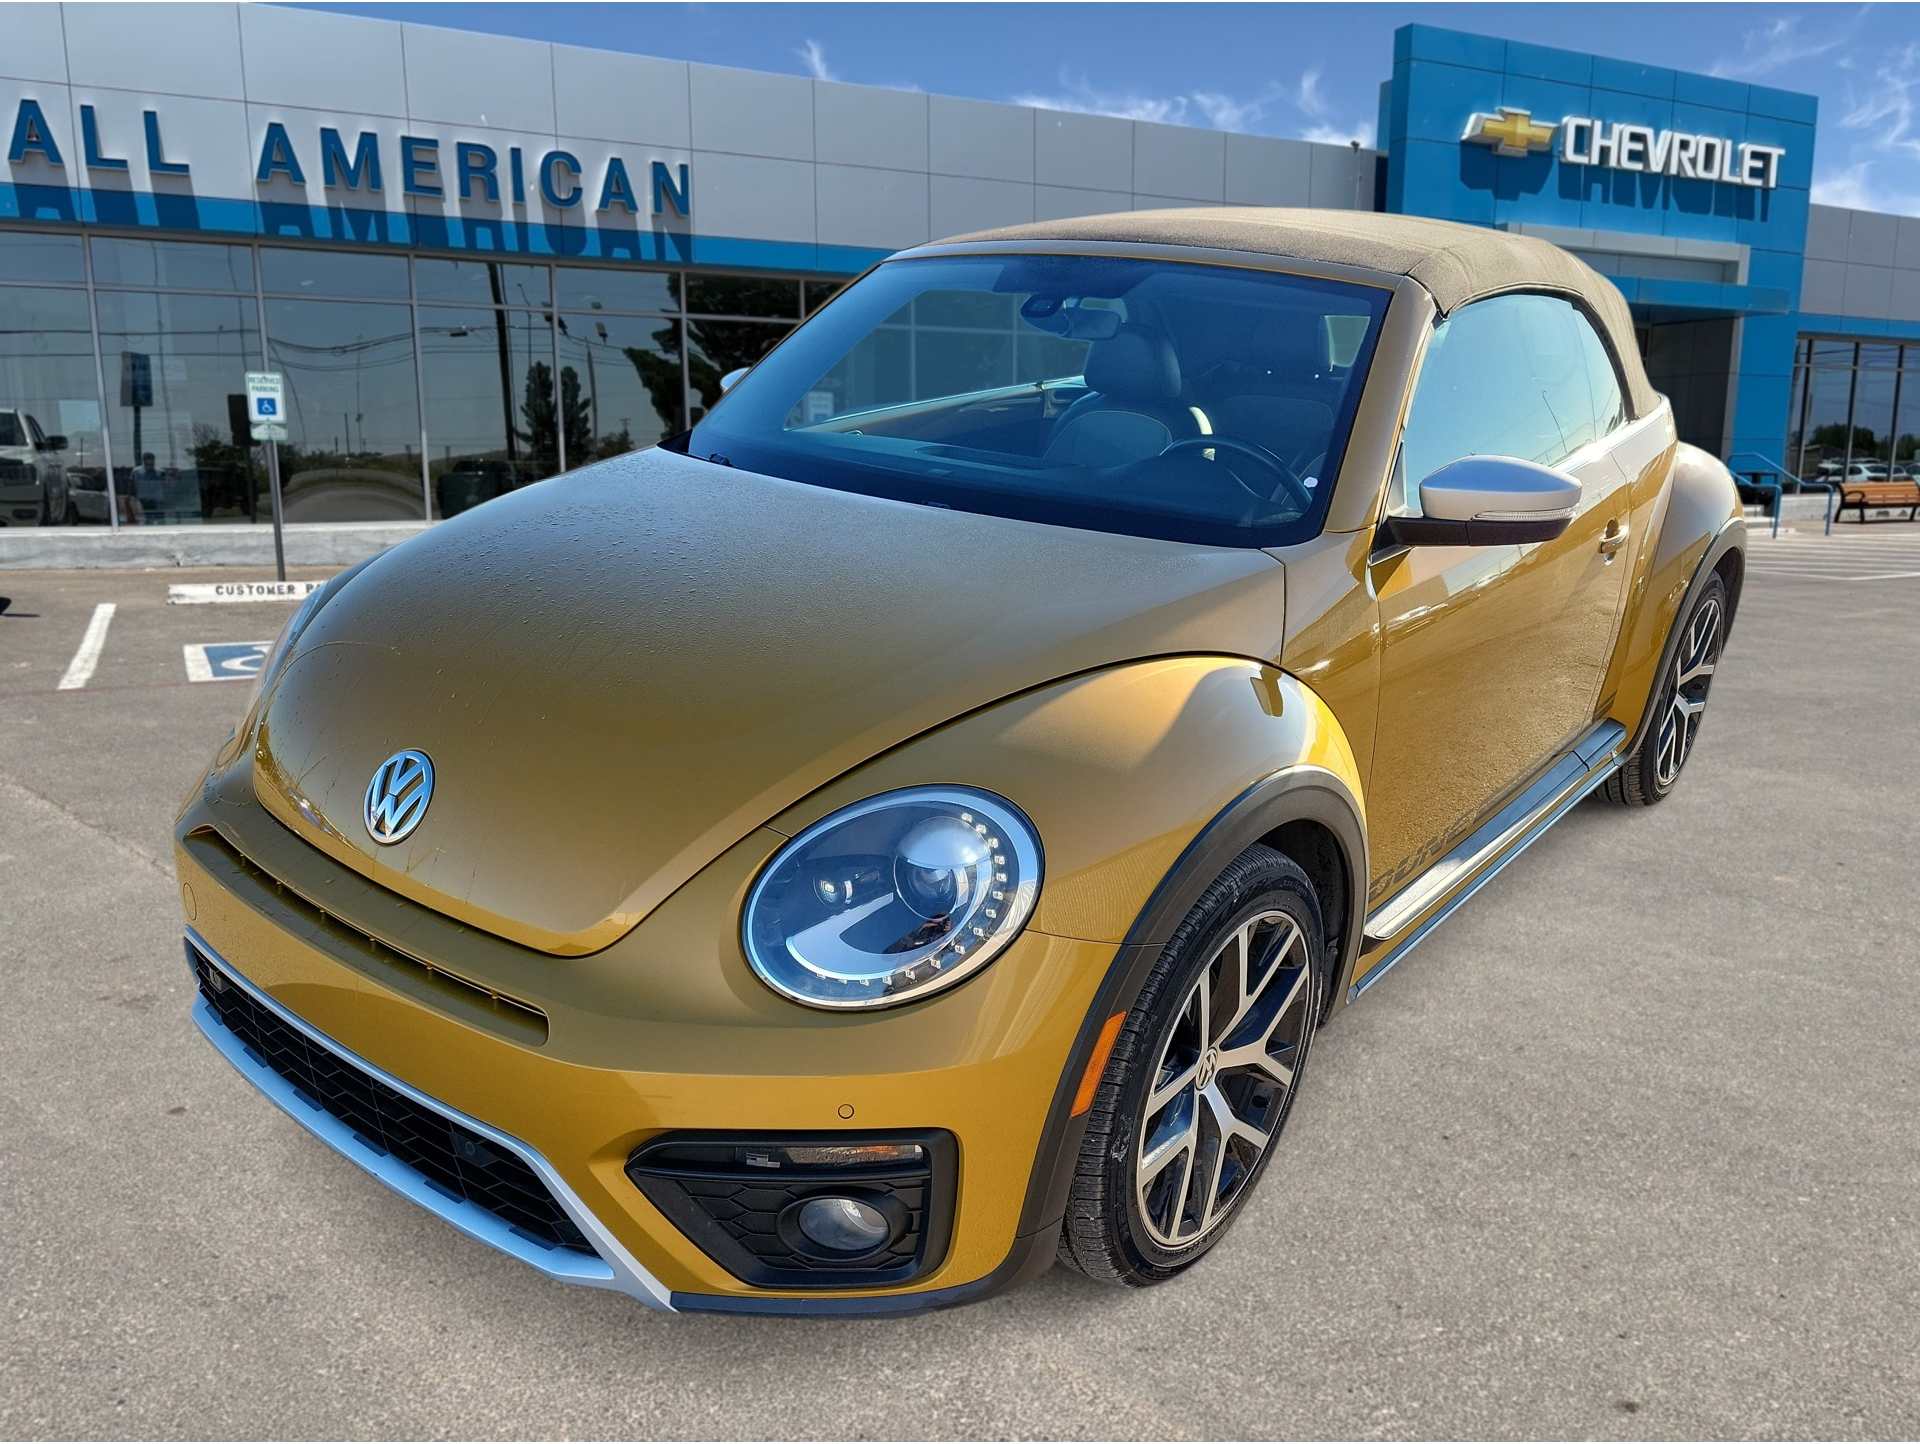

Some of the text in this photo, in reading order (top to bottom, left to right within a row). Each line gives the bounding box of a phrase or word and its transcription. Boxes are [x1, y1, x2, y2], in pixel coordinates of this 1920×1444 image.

[8, 98, 691, 217] ALL AMERICAN
[1562, 115, 1786, 188] CHEVROLET
[215, 585, 296, 596] CUSTOMER
